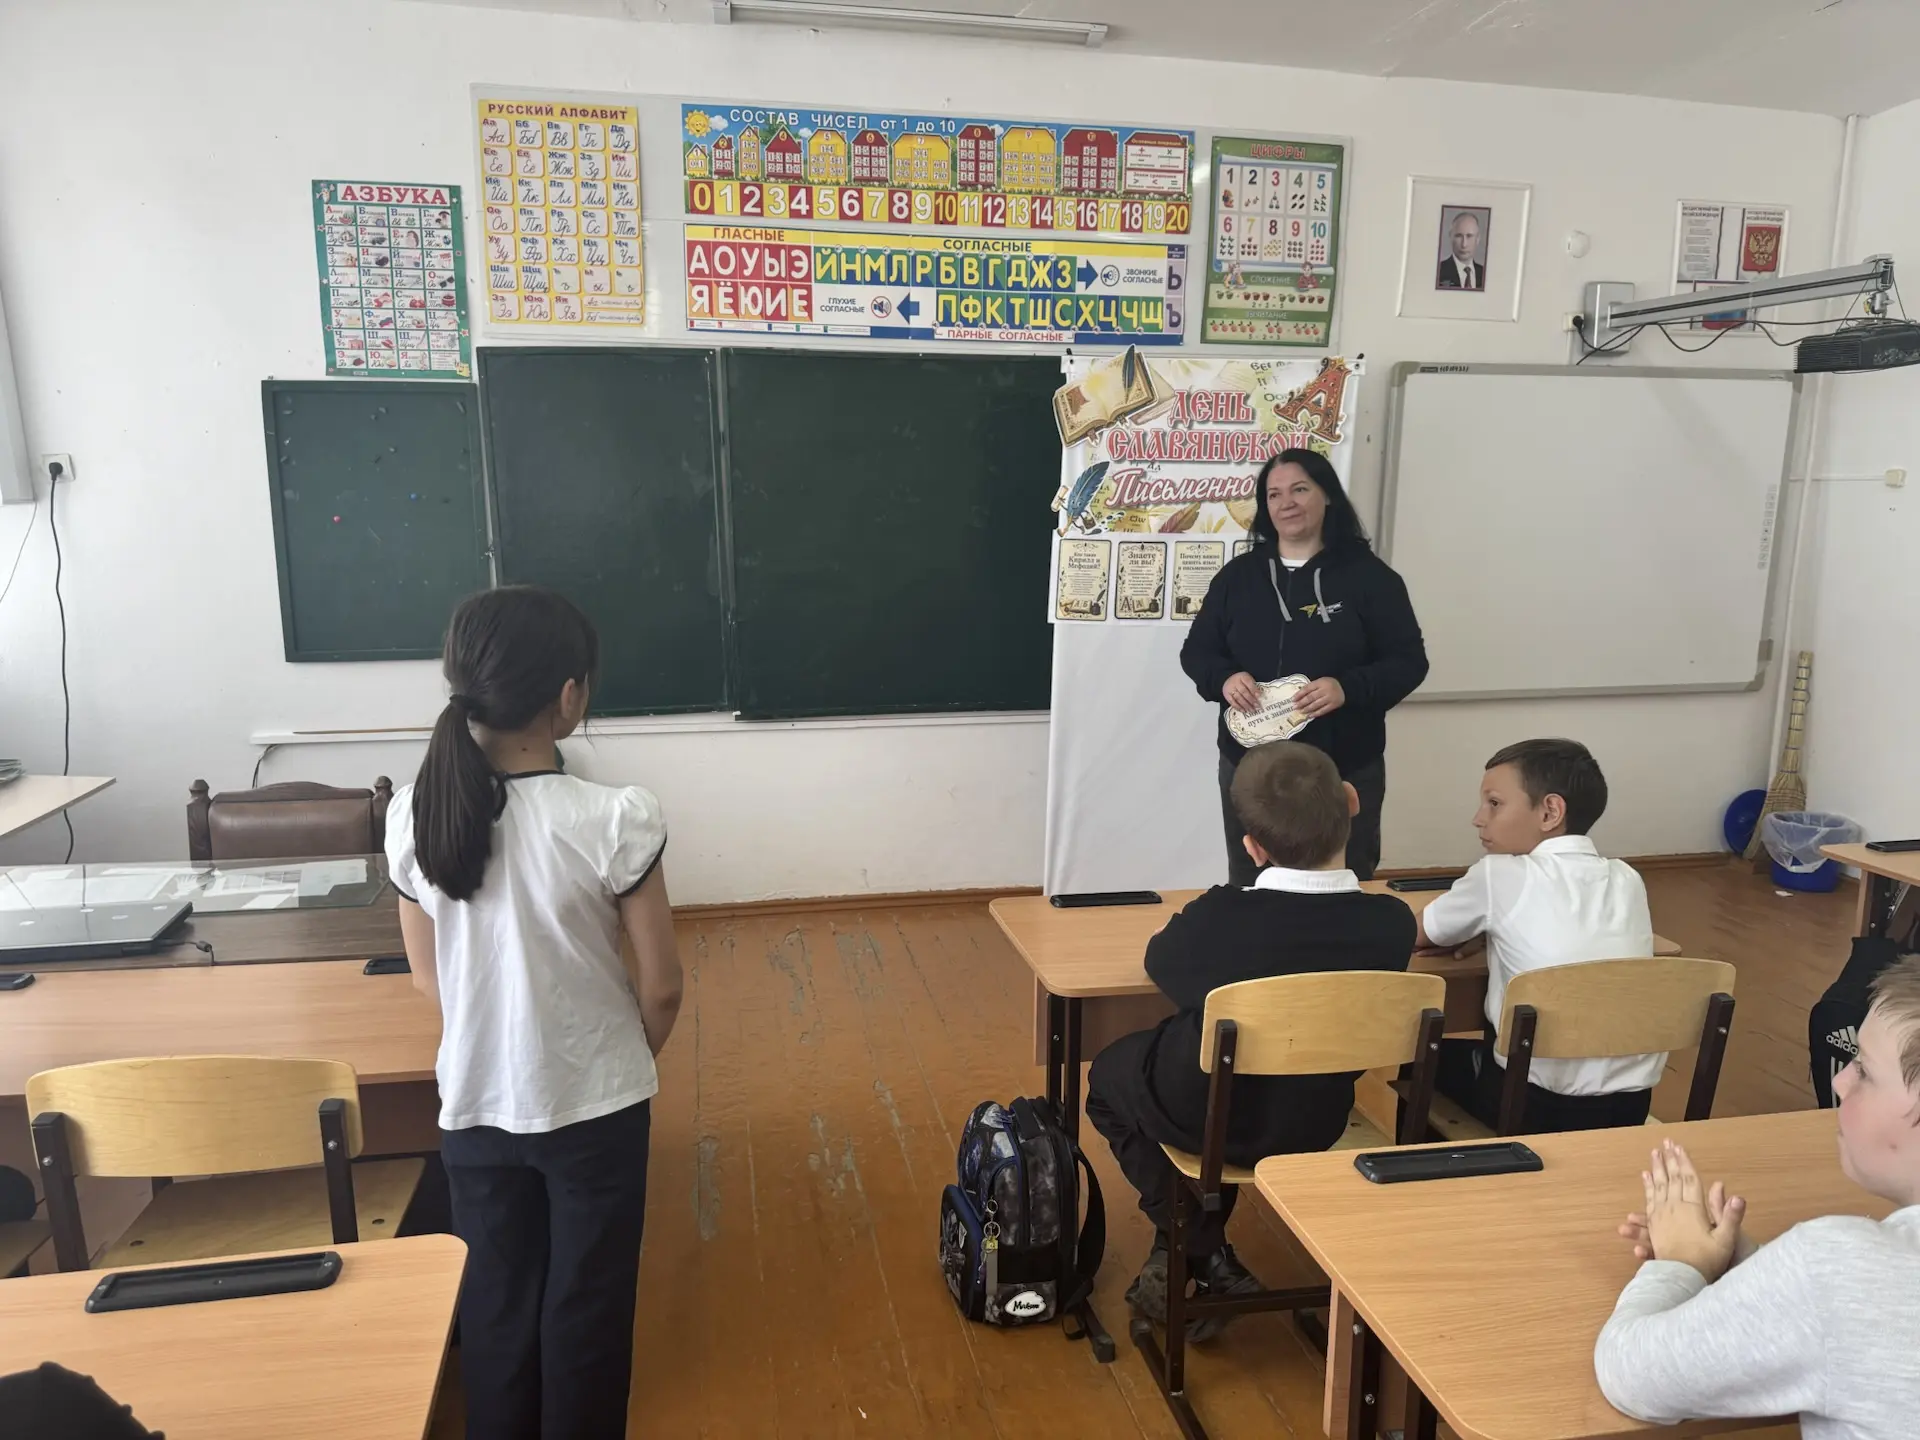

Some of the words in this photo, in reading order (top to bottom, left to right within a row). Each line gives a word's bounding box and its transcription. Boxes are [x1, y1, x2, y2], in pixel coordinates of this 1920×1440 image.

[488, 103, 553, 116] РУССКИЙ
[560, 108, 627, 120] АЛФАВИТ
[729, 109, 799, 125] СОСТАВ
[811, 114, 868, 129] ЧИСЕЛ
[881, 119, 896, 129] от
[902, 119, 908, 130] 1
[915, 121, 934, 133] до
[940, 121, 955, 133] 10
[1251, 144, 1306, 159] ЦИФРЫ
[1226, 168, 1234, 184] 1
[1248, 169, 1257, 185] 2
[1271, 170, 1280, 186] 3
[1293, 172, 1304, 188] 4
[1316, 174, 1326, 189] 5
[341, 185, 448, 204] АЗБУКА
[693, 183, 710, 211] 0
[720, 184, 733, 212] 1
[744, 186, 761, 213] 2
[768, 187, 787, 215] 3
[790, 188, 809, 215] 4
[817, 188, 836, 216] 5
[842, 190, 860, 216] 6
[867, 191, 885, 218] 7
[893, 192, 910, 219] 8
[915, 193, 932, 220] 9
[936, 195, 957, 221] 10
[960, 197, 980, 222] 11
[983, 198, 1005, 224] 12
[1008, 199, 1030, 225] 13
[1032, 200, 1052, 226] 14
[1055, 201, 1076, 227] 15
[1077, 202, 1097, 228] 16
[1100, 202, 1121, 229] 17
[1122, 203, 1142, 230] 18
[1146, 204, 1165, 230] 19
[1166, 205, 1189, 231] 20
[713, 227, 785, 242] ГЛАСНЫЕ
[1224, 216, 1233, 233] 6
[1246, 218, 1255, 234] 7
[1269, 220, 1278, 236] 8
[1291, 220, 1300, 237] 9
[1311, 222, 1327, 239] 10
[943, 239, 1032, 252] СОГЛАСНЫЕ
[689, 245, 710, 274] А
[713, 246, 737, 277] О
[740, 247, 759, 277] У
[764, 248, 787, 278] Ы
[791, 249, 809, 279] Э
[815, 248, 837, 281] Й
[840, 252, 861, 282] Н
[864, 254, 886, 283] М
[889, 254, 908, 283] Л
[916, 255, 932, 283] Р
[940, 256, 957, 285] Б
[963, 258, 980, 285] В
[988, 259, 1003, 286] Г
[1007, 259, 1027, 288] Д
[1030, 260, 1052, 287] Ж
[1057, 260, 1072, 289] З
[1126, 269, 1158, 277] ЗВОНКИЕ
[1123, 275, 1164, 284] СОГЛАСНЫЕ
[691, 284, 710, 314] Я
[718, 281, 734, 315] Ё
[740, 286, 763, 316] Ю
[765, 287, 787, 317] И
[793, 289, 809, 317] Е
[820, 304, 865, 314] СОГЛАСНЫЕ
[828, 297, 856, 306] ГЛУХИЕ
[938, 293, 957, 323] П
[960, 294, 981, 324] Ф
[985, 297, 1003, 325] К
[1009, 298, 1026, 326] Т
[1029, 298, 1050, 326] Ш
[1054, 298, 1072, 327] С
[1077, 300, 1095, 328] Х
[1098, 300, 1118, 328] Ц
[1121, 301, 1138, 329] Ч
[1141, 301, 1163, 330] Щ
[948, 329, 993, 340] ПАРНЫЕ
[999, 331, 1064, 342] СОГЛАСНЫЕ
[1168, 389, 1254, 427] ДЕНЬ
[1105, 467, 1259, 509] Письменно
[1826, 1034, 1858, 1055] adida
